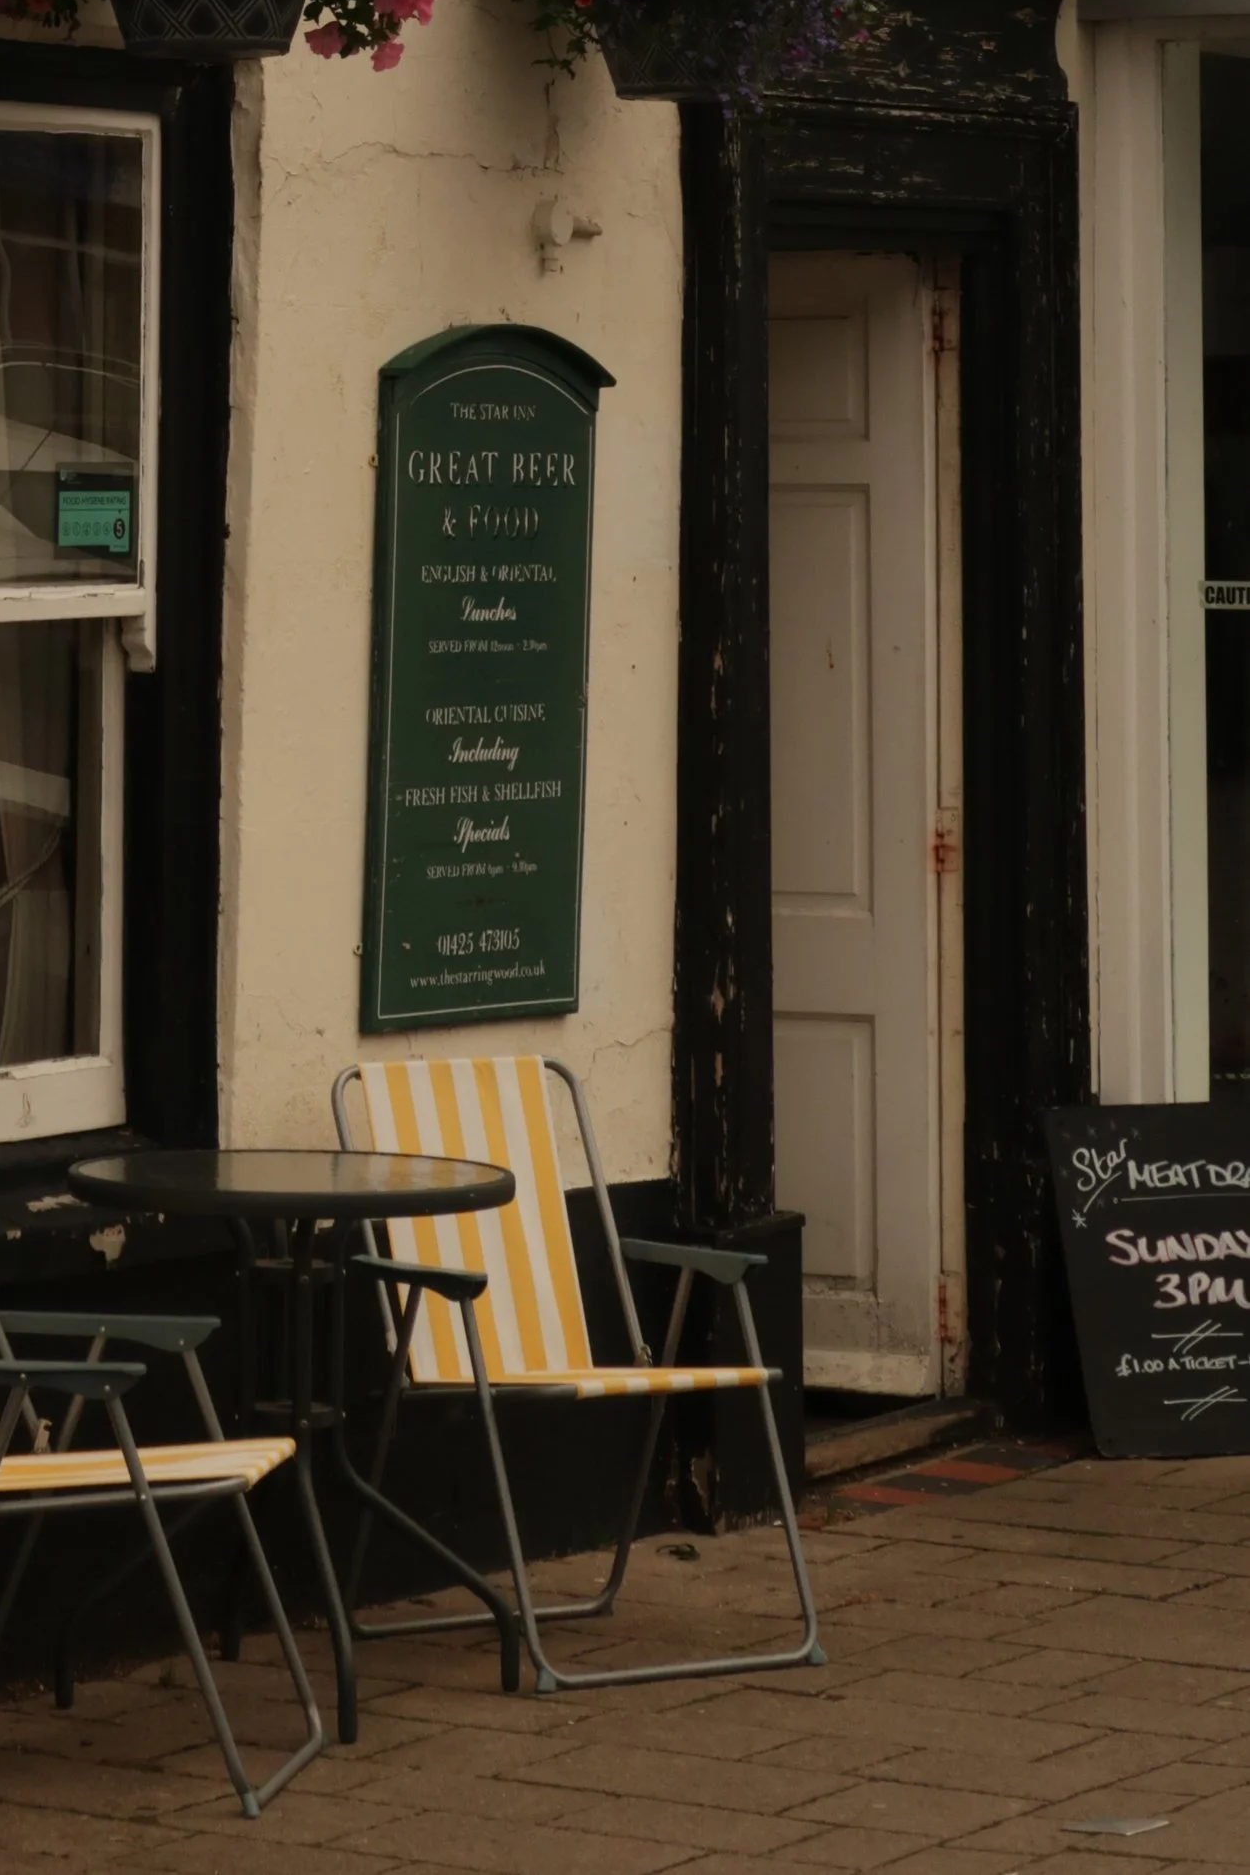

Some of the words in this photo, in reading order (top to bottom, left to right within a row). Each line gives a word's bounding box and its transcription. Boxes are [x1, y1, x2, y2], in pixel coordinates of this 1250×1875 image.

[450, 402, 476, 420] THE
[480, 403, 509, 420] STAR
[513, 404, 537, 421] INN
[408, 449, 499, 485] GREAT
[512, 452, 576, 486] BEER
[442, 505, 457, 537] &
[469, 504, 539, 537] FOOD
[421, 564, 476, 583] ENGLISH
[480, 565, 488, 582] &
[492, 563, 557, 583] ORIENTAL
[460, 595, 517, 621] Lunches
[428, 639, 462, 653] SERVED
[464, 639, 488, 653] FROM
[425, 705, 492, 725] ORIENTAL
[494, 703, 546, 722] CUISINE
[448, 736, 520, 771] Including
[405, 787, 445, 807] FRESH
[450, 785, 478, 804] FISH
[482, 785, 491, 802] &
[494, 780, 562, 802] SHELLFISH
[453, 815, 510, 854] Specials
[426, 865, 460, 880] SERVED
[461, 862, 487, 877] FROM
[438, 931, 474, 956] 01425
[479, 928, 520, 952] 473105
[410, 959, 546, 988] www.thestarringwood.co.uk
[1072, 1138, 1128, 1191] Star
[1127, 1159, 1207, 1191] MEAT
[1205, 1161, 1250, 1188] DR
[1115, 1353, 1164, 1377] £1.00
[1168, 1357, 1181, 1371] A
